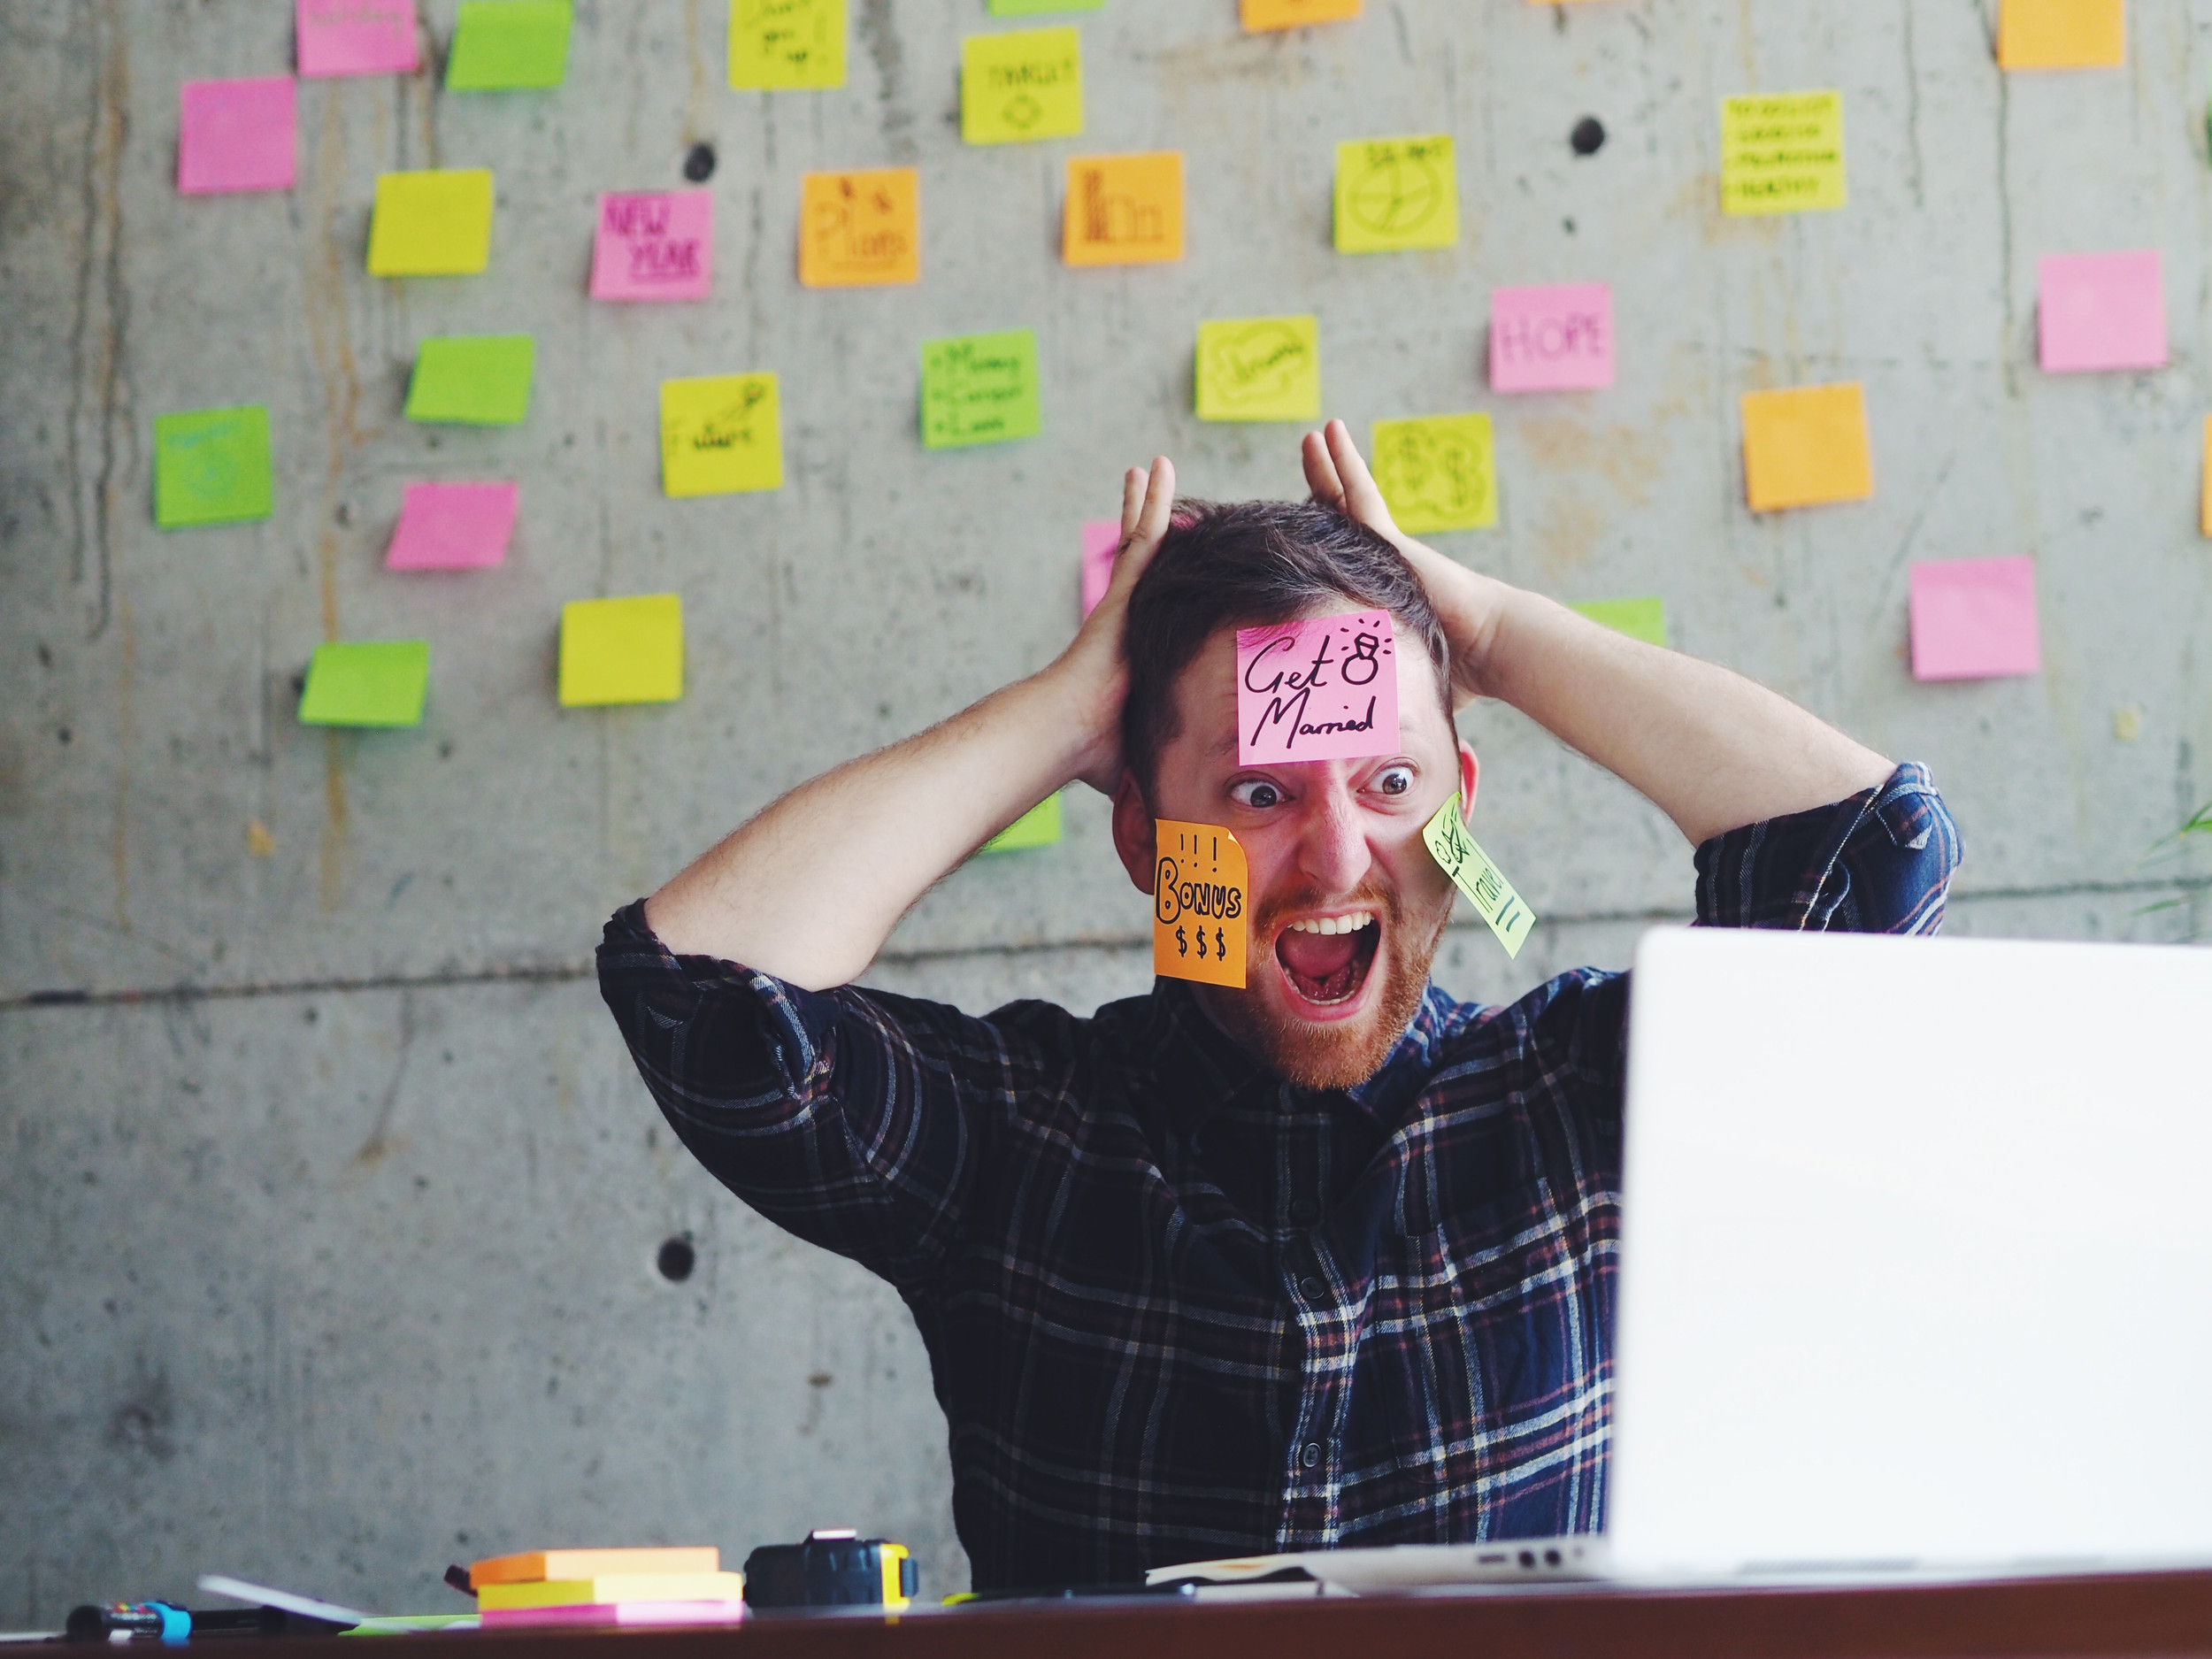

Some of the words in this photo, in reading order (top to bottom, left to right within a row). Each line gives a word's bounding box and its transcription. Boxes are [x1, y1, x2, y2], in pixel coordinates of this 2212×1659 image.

[604, 196, 671, 236] NEW
[627, 240, 701, 275] YEAR
[1501, 311, 1605, 364] HOPE
[1244, 634, 1334, 695] Get
[1249, 687, 1377, 749] Married
[1451, 837, 1504, 914] Travel
